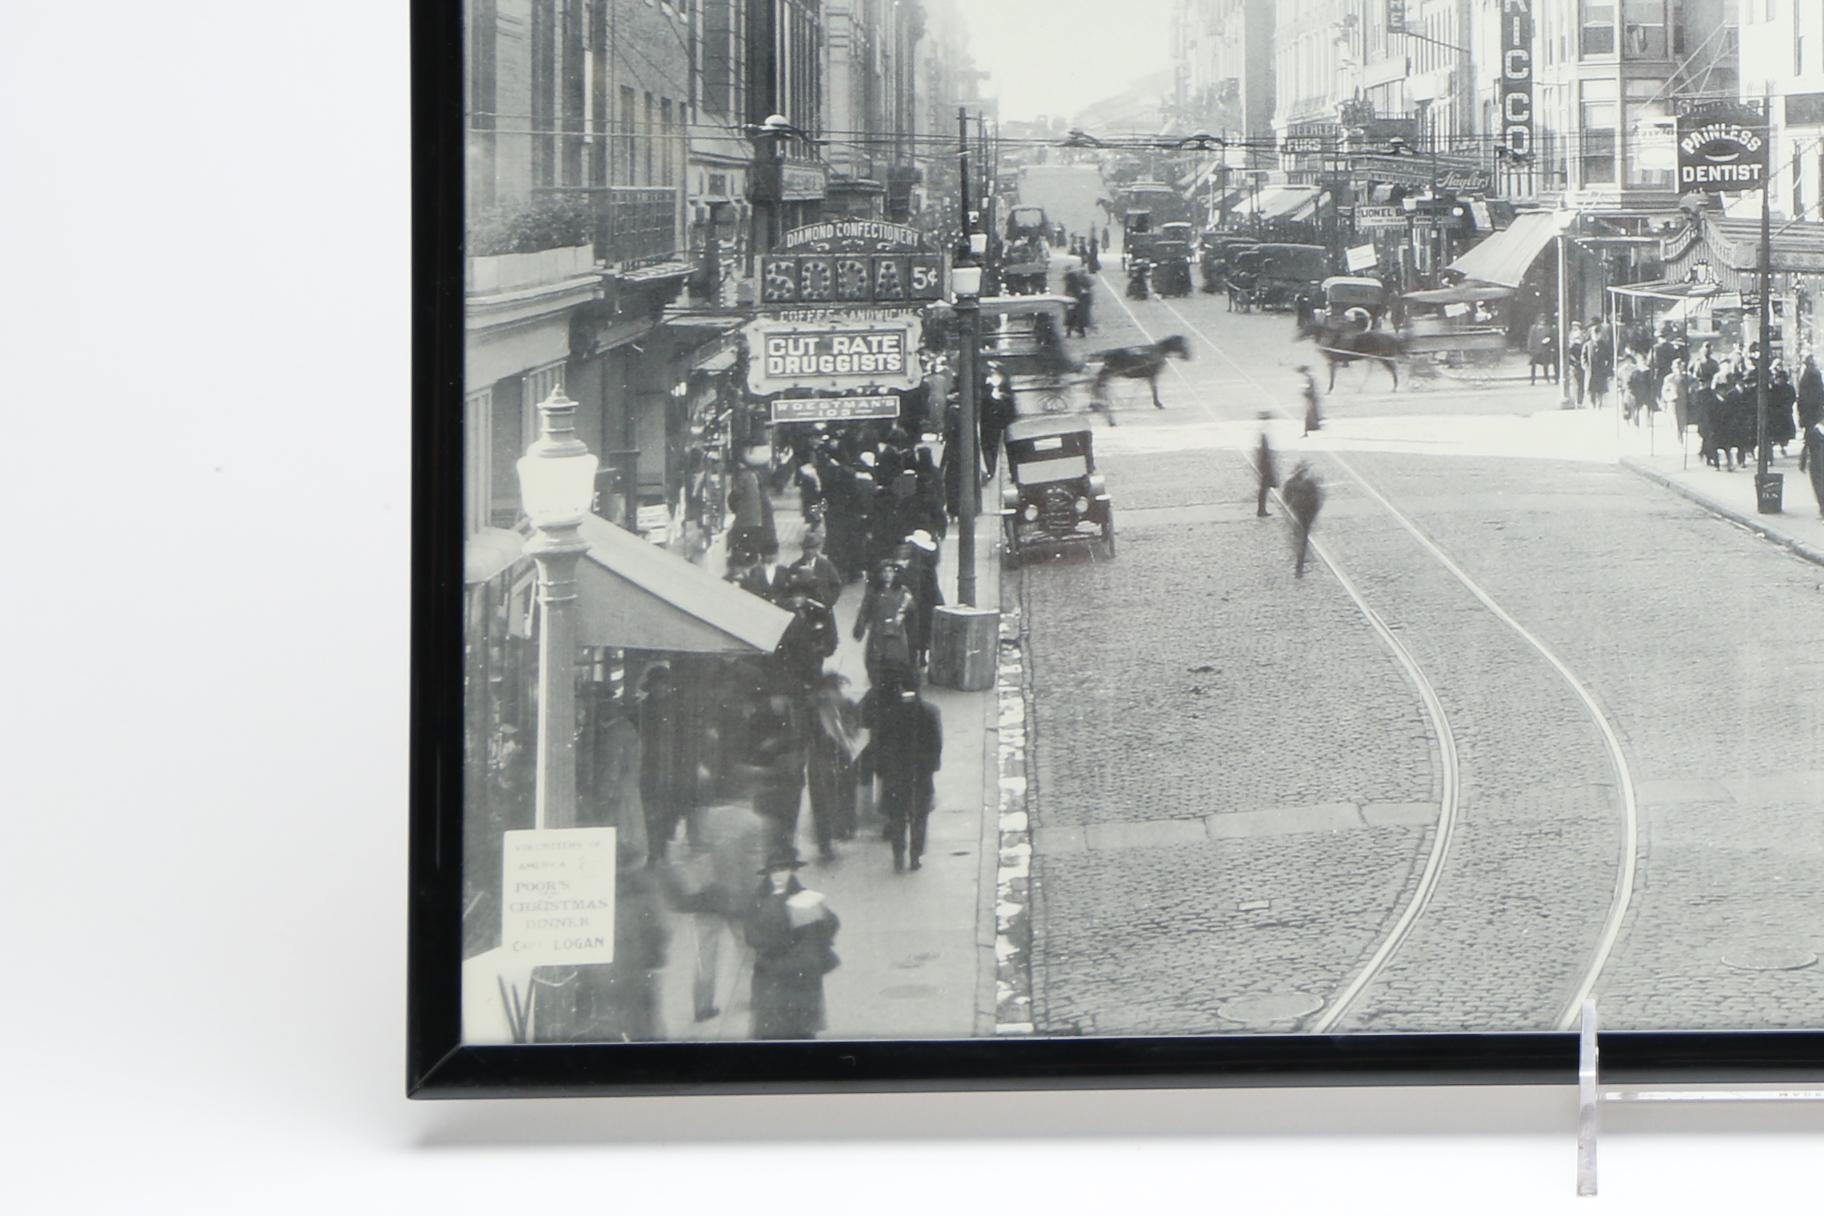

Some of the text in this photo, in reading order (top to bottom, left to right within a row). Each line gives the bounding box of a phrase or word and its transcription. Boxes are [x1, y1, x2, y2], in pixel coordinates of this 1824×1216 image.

[1505, 92, 1530, 155] CO
[1287, 138, 1322, 152] FURS
[1681, 123, 1762, 155] PAINLESS
[1682, 164, 1763, 183] DENTIST
[1360, 207, 1393, 218] LIONEL
[787, 221, 919, 248] DIAMOND CONFECTIONERY
[766, 260, 903, 299] SODA
[912, 266, 938, 290] 5¢
[768, 335, 900, 356] CUT RATE
[768, 354, 901, 374] DRUGGISTS
[509, 898, 609, 914] CHRISTMAS
[525, 915, 591, 930] DINNER
[553, 936, 605, 952] LOGAN
